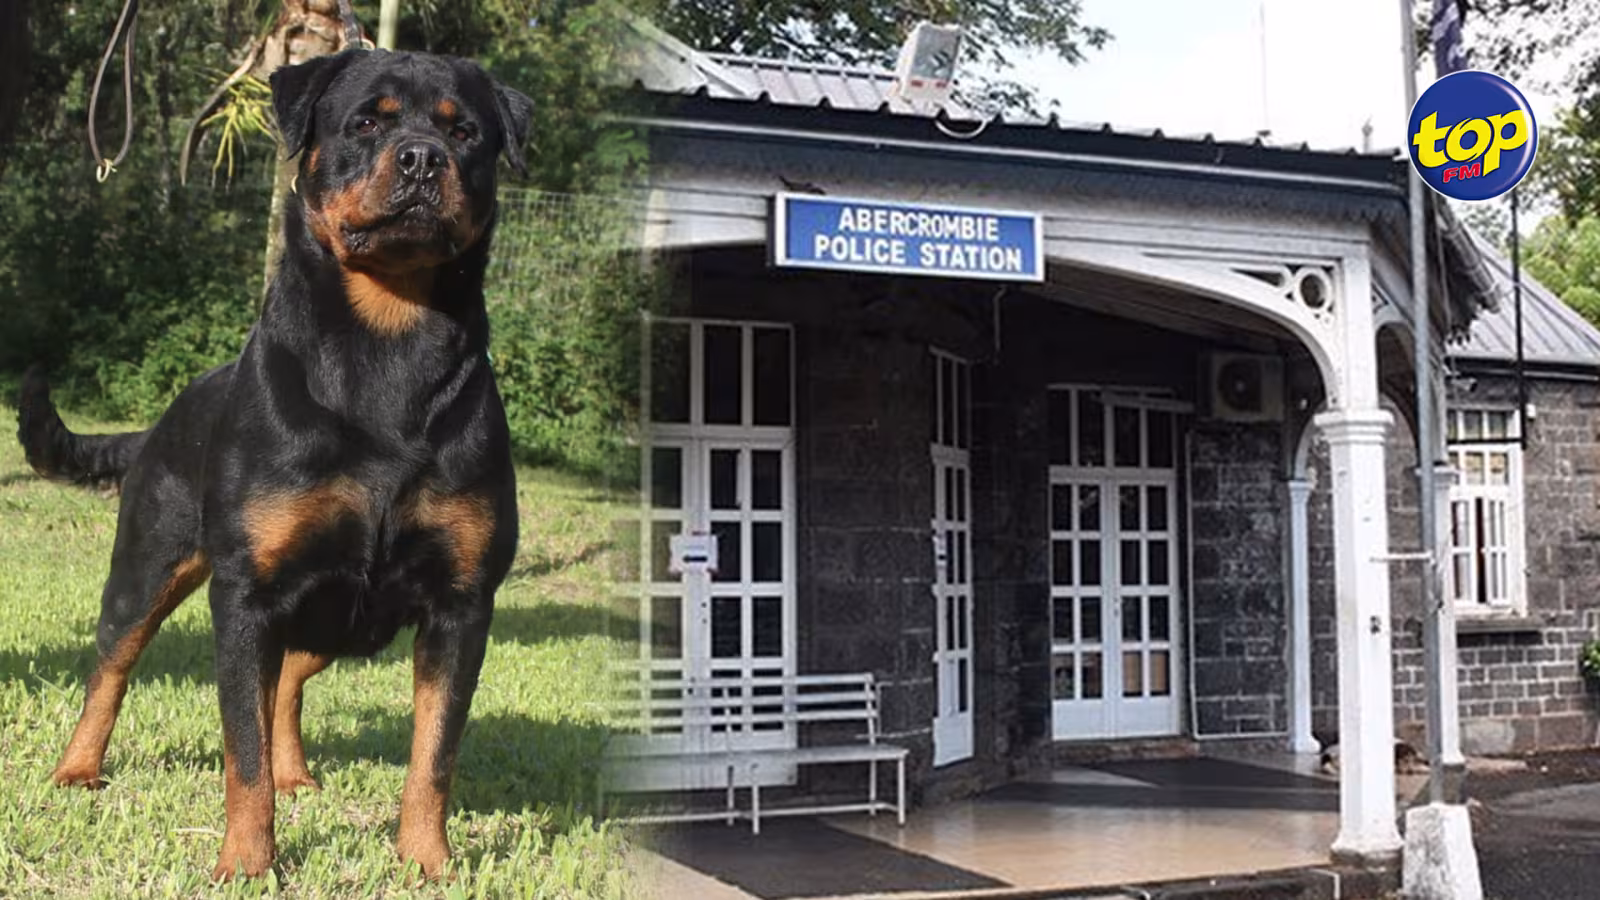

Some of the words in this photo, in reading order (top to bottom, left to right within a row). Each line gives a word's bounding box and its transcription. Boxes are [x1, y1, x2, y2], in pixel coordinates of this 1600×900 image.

[838, 206, 1000, 242] ABERCROMBIE
[814, 234, 906, 265] POLICE
[920, 242, 1022, 272] STATION
